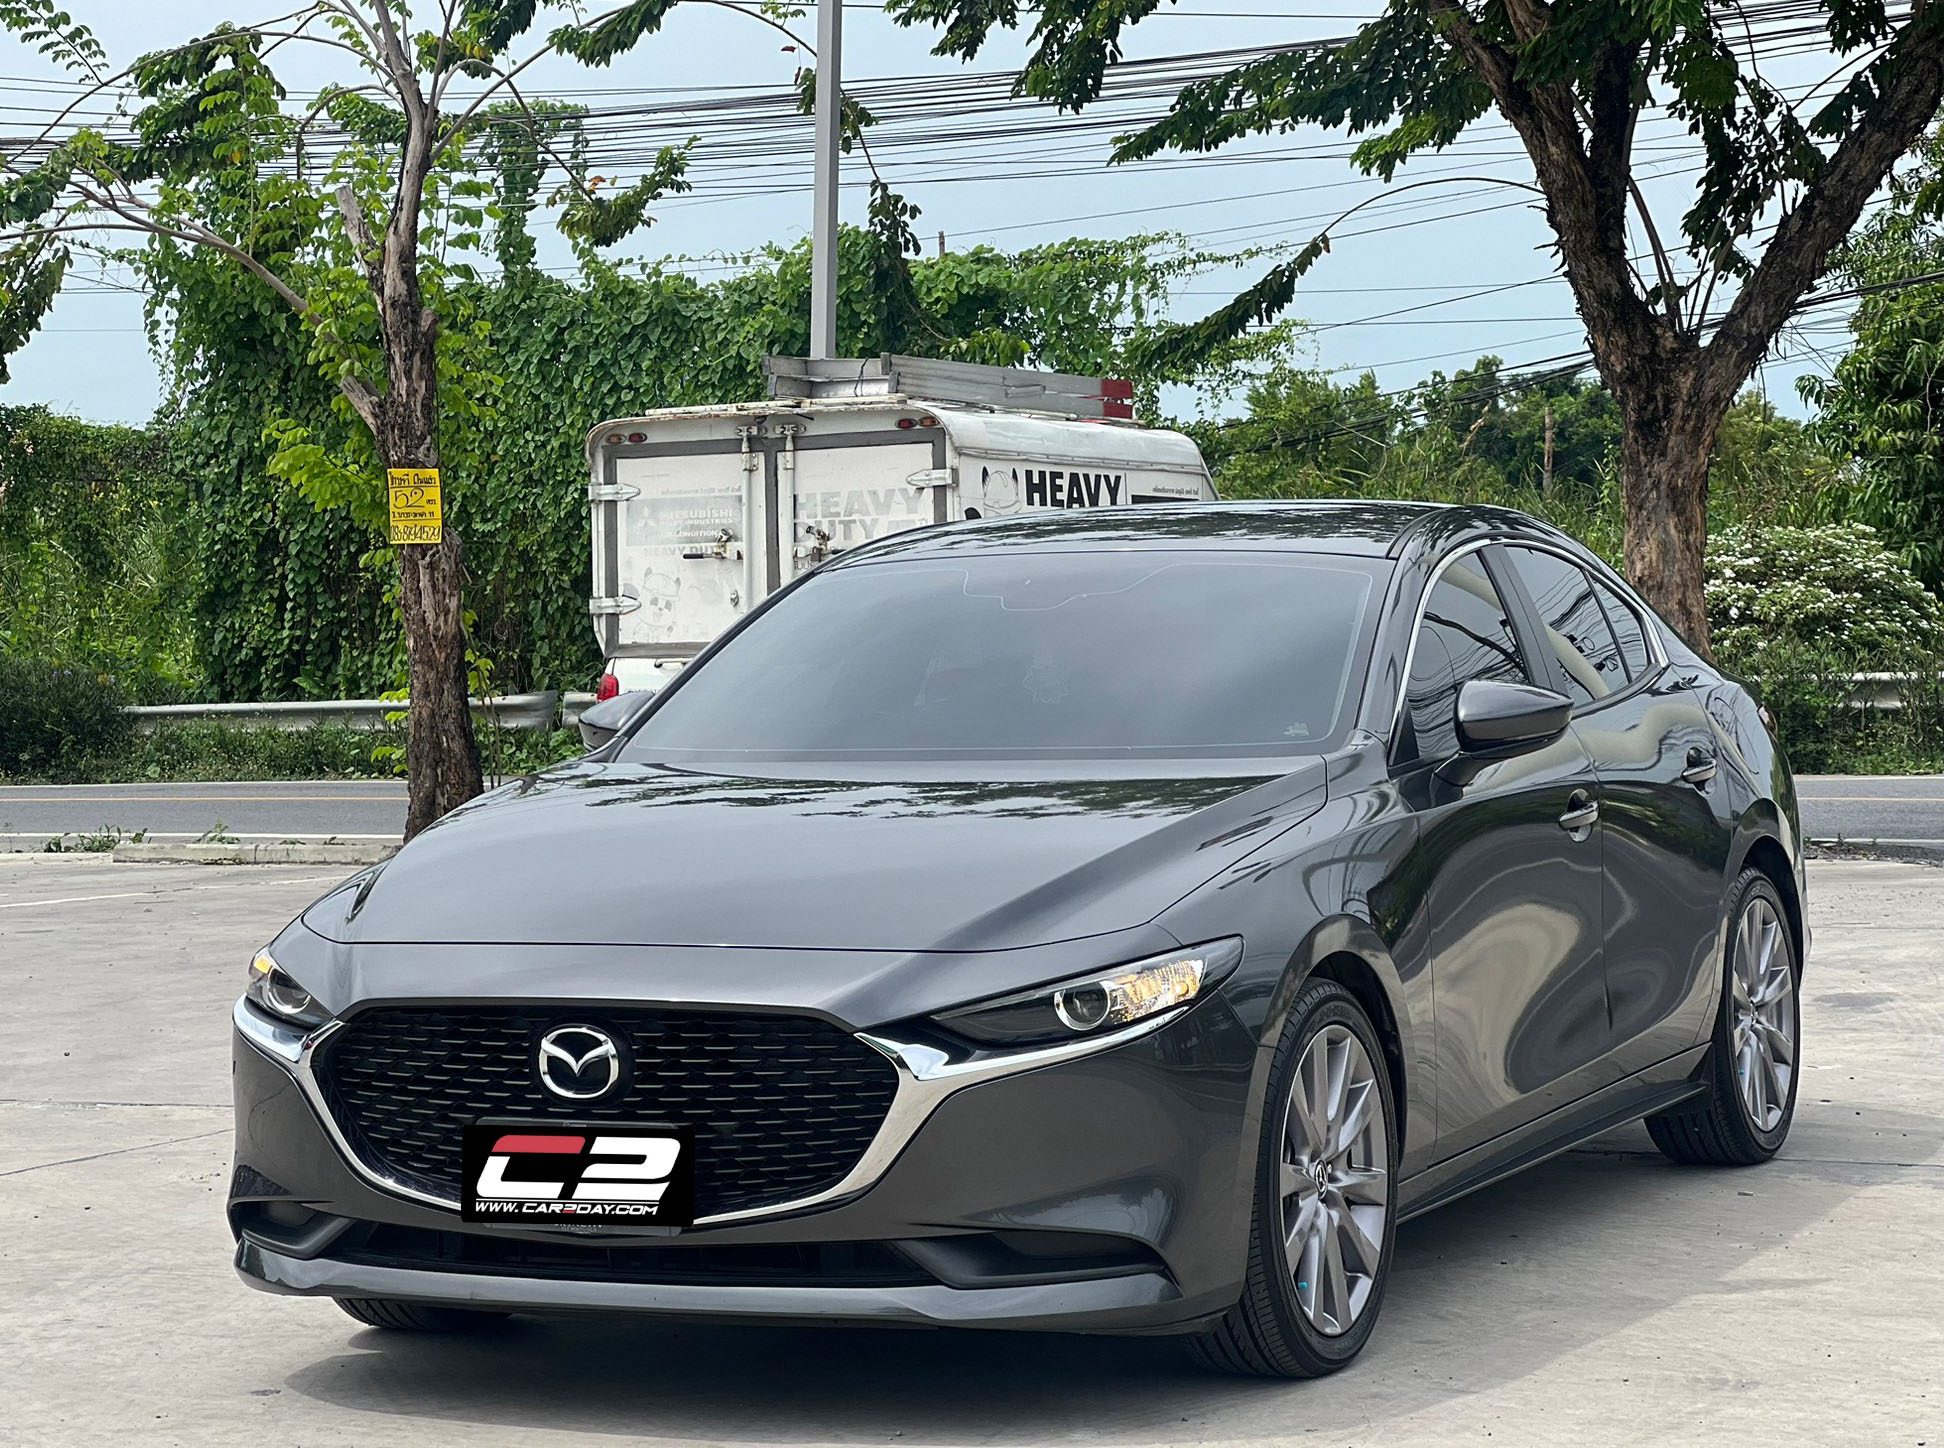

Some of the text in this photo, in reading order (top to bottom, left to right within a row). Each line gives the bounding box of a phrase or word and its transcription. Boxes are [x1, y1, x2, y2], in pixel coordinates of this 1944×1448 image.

[392, 487, 425, 509] 52
[793, 487, 926, 520] HEAVY
[1025, 469, 1122, 508] HEAVY
[793, 517, 879, 544] DUTY
